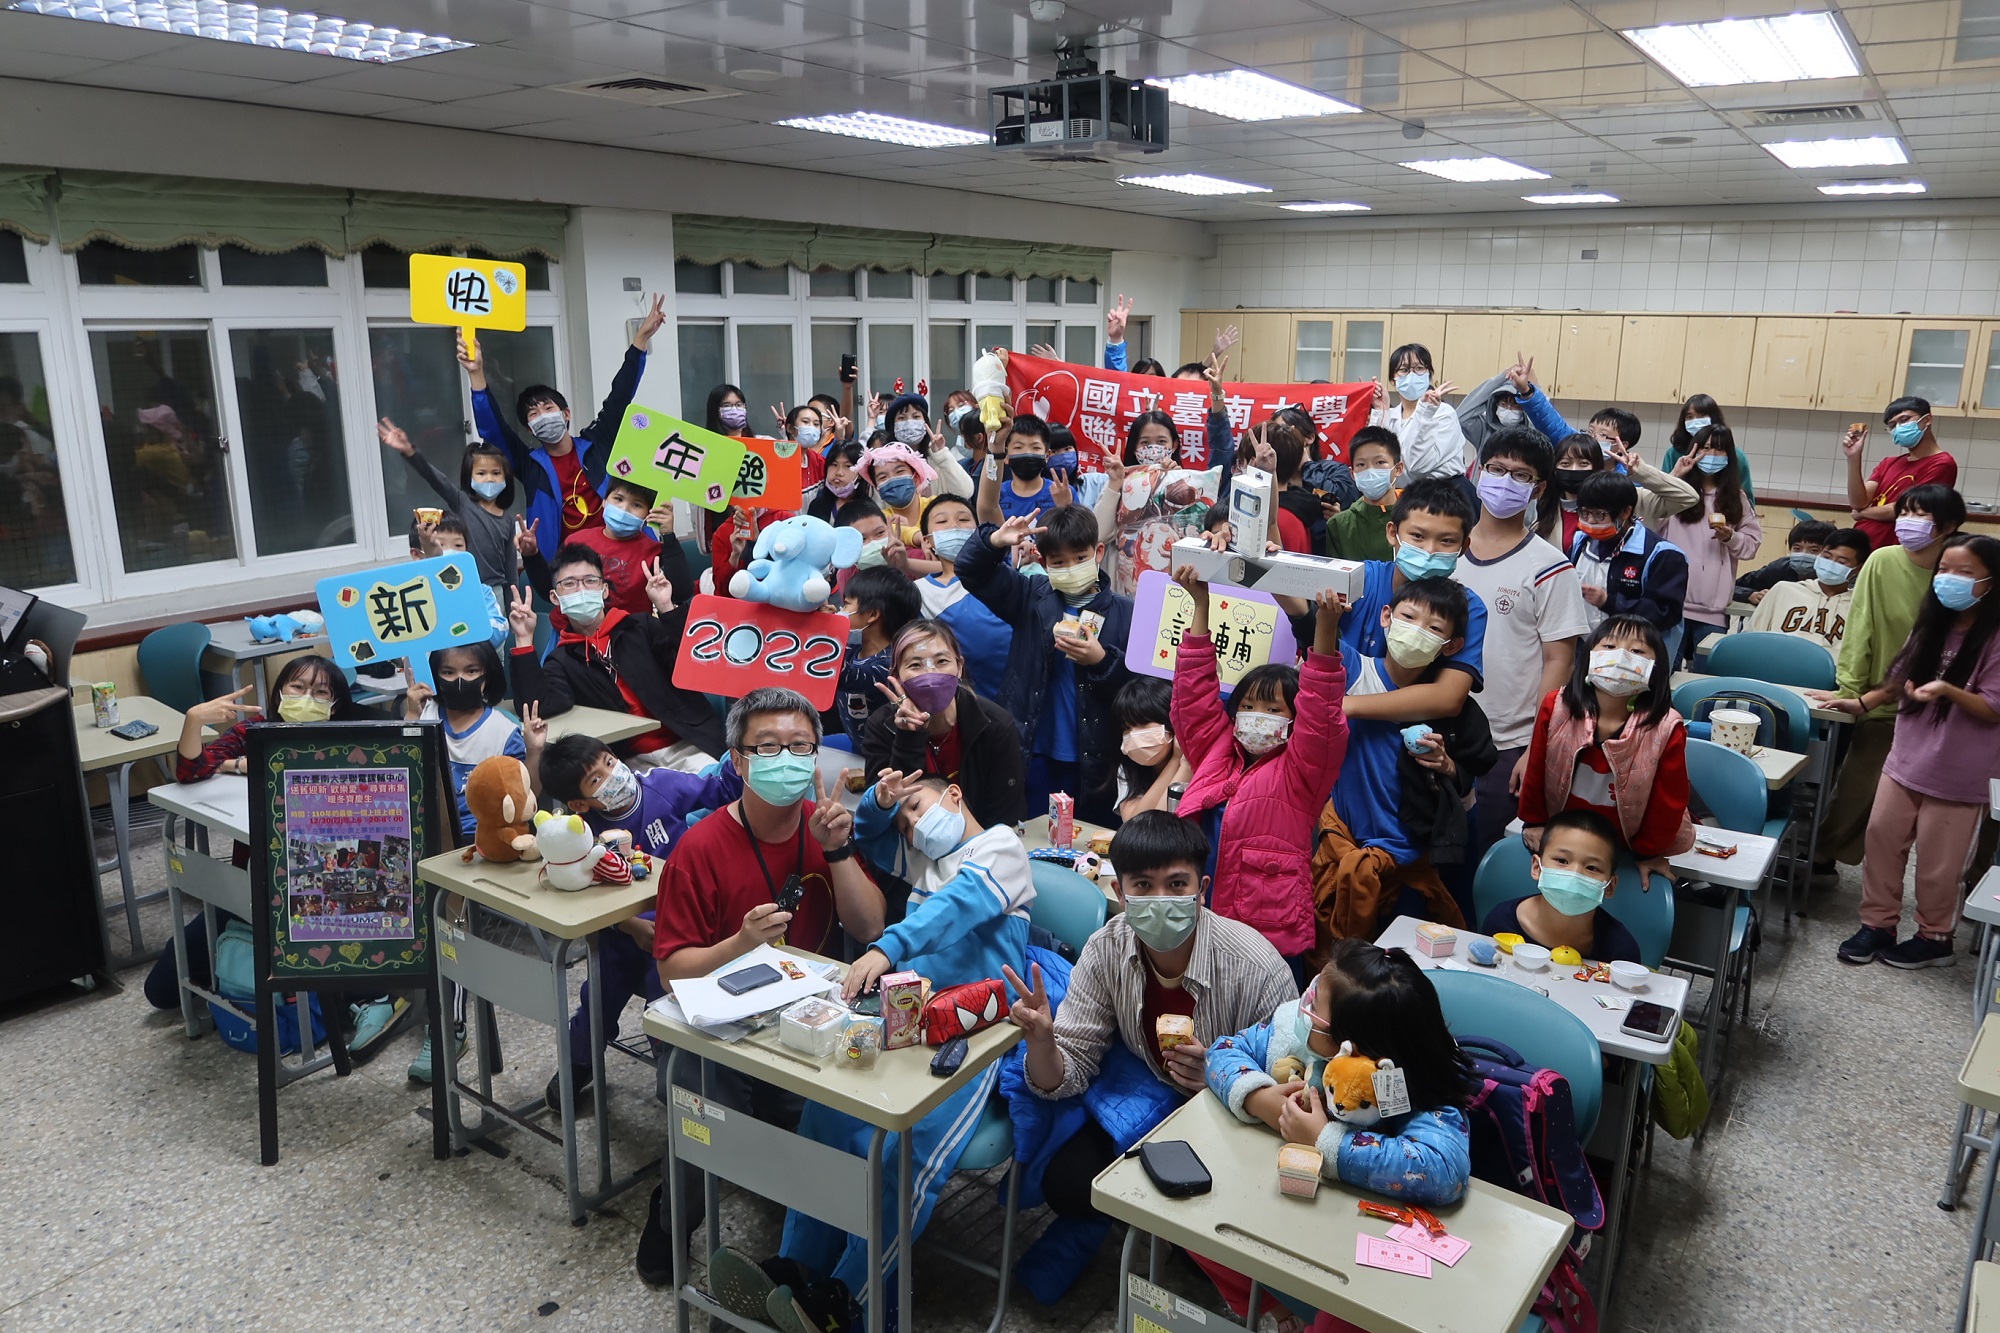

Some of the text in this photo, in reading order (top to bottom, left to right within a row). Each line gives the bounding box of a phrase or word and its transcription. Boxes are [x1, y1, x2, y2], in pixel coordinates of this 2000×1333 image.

[448, 271, 489, 312] 快
[659, 432, 704, 481] 年
[370, 583, 430, 641] 新
[1781, 606, 1846, 646] GAP
[686, 618, 843, 680] 2022
[290, 785, 327, 795] 送舊迎新
